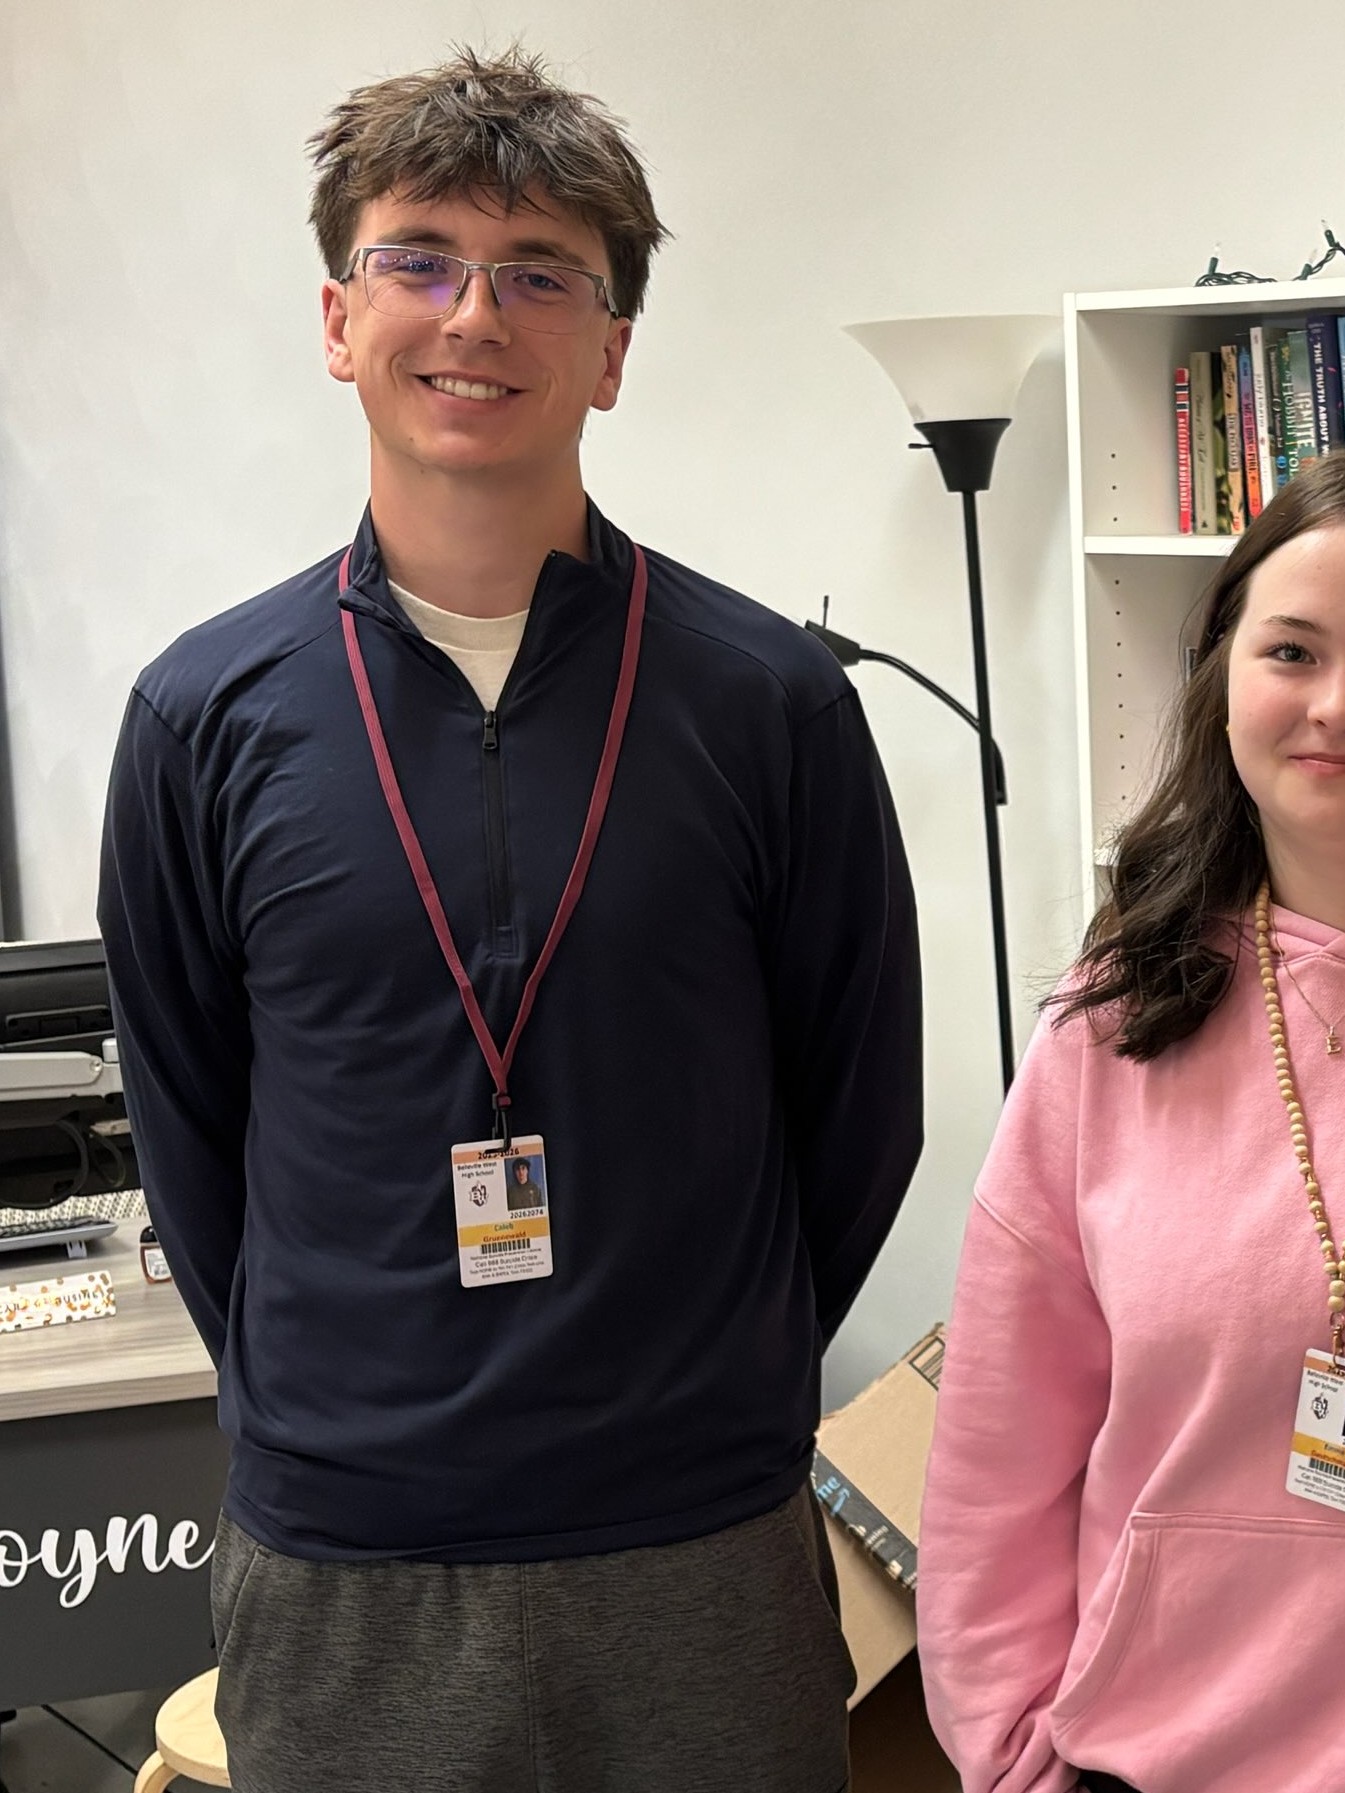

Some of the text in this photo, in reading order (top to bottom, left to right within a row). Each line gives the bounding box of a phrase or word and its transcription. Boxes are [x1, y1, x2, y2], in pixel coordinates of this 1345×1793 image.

[1313, 342, 1323, 364] THE
[1316, 367, 1325, 403] TRUTH
[1282, 382, 1298, 439] HOBBIT
[1293, 391, 1315, 448] IGNITE
[1318, 406, 1329, 441] ABOUT
